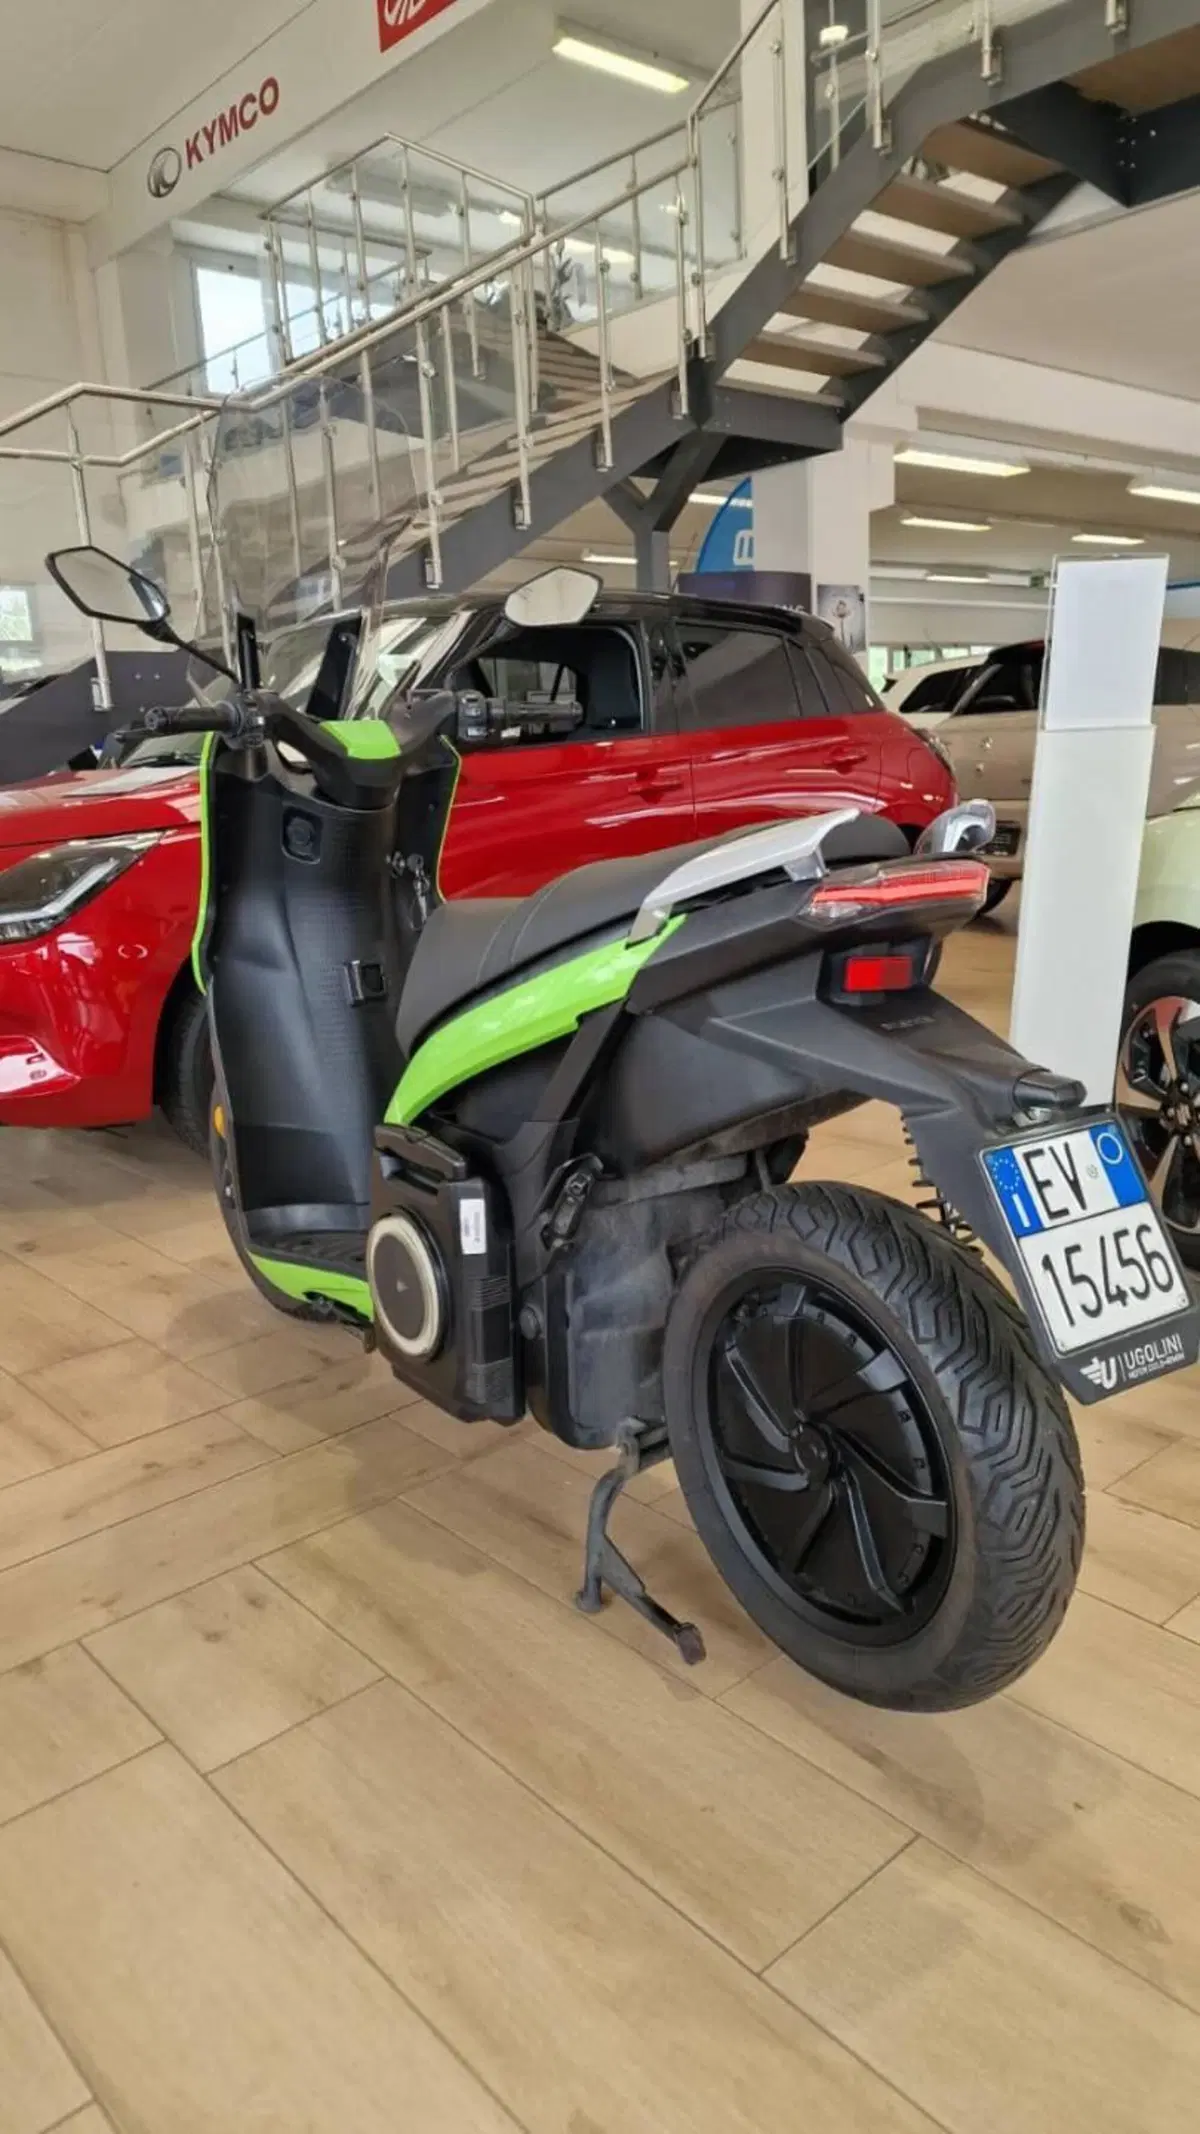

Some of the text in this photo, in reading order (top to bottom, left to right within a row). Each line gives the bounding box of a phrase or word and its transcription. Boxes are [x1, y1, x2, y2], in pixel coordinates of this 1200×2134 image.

[185, 76, 279, 169] KYMCO
[1023, 1142, 1087, 1220] EV
[1042, 1224, 1174, 1327] 15456
[1124, 1332, 1183, 1370] UGOLINI
